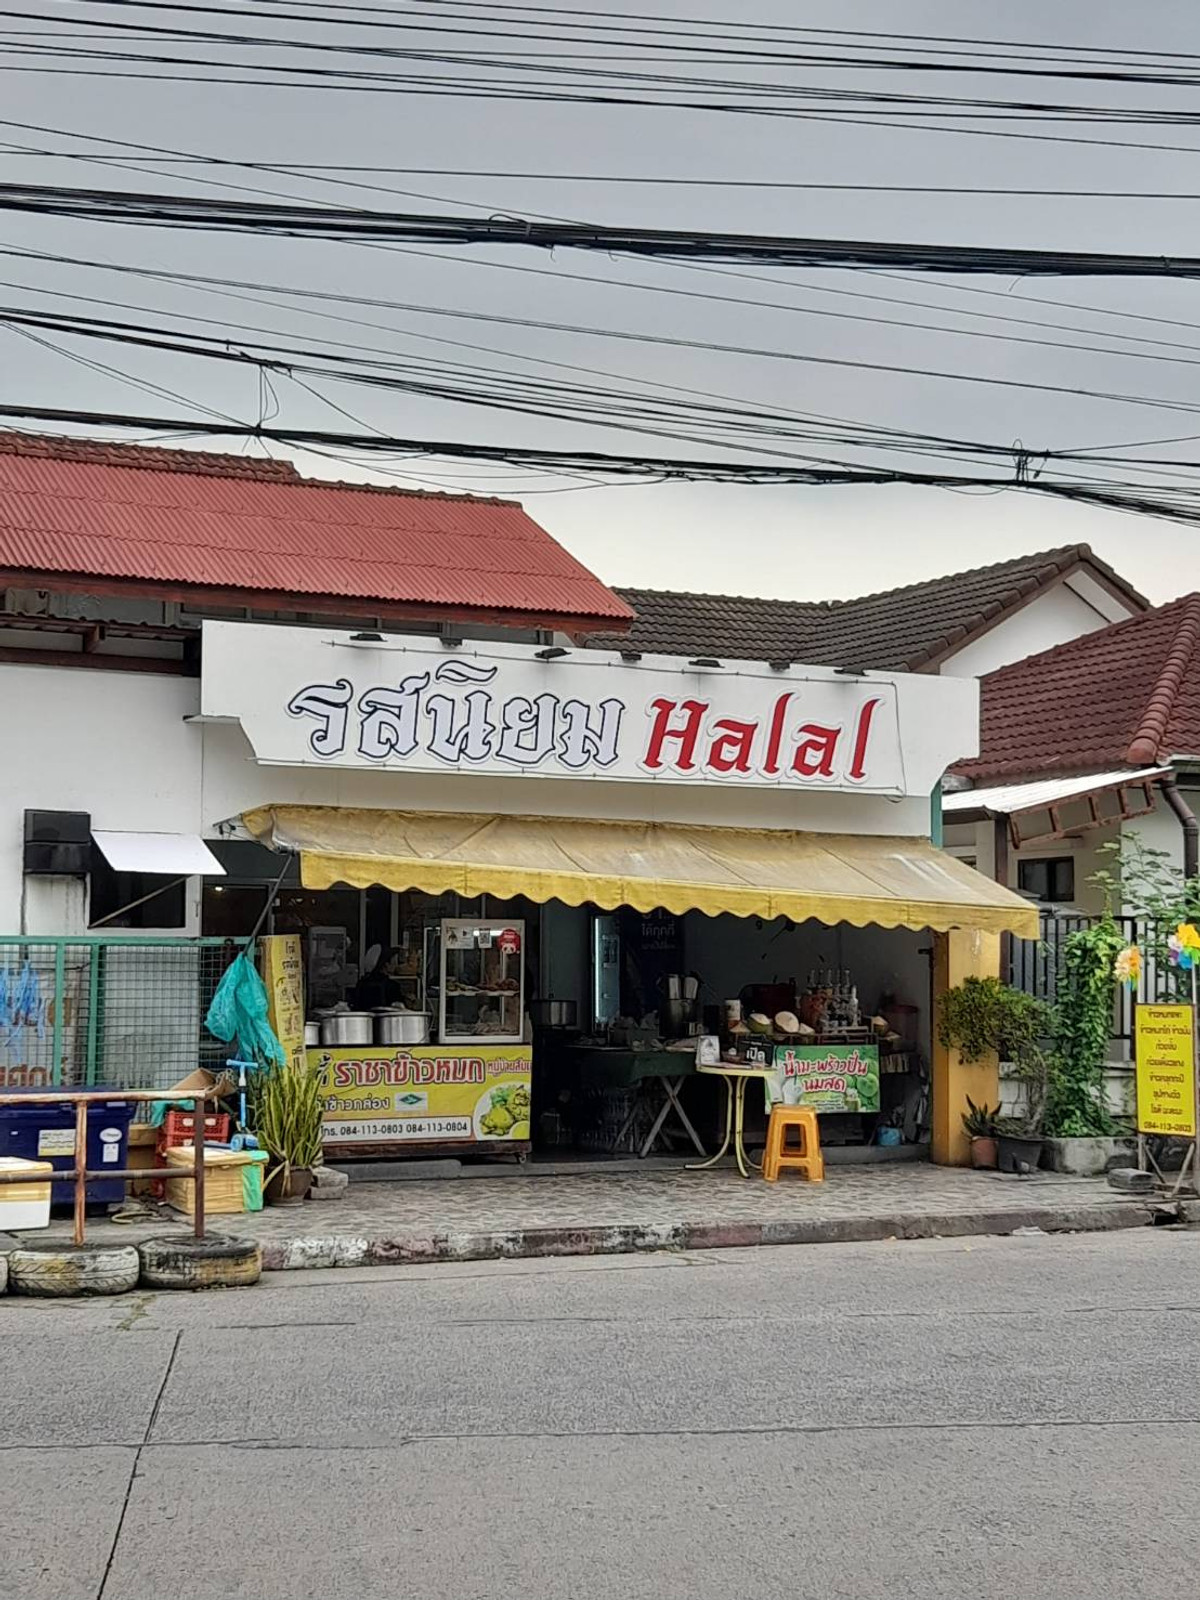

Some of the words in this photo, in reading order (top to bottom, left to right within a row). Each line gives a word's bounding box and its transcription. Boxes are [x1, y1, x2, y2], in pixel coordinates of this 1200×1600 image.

[286, 660, 624, 768] รสนิยม
[643, 691, 881, 779] Halal
[335, 1051, 485, 1087] ราชาข้าวหมก
[783, 1050, 867, 1076] น้ำมะพร้าวปั่น
[803, 1077, 846, 1092] นมสด
[340, 1124, 403, 1136] 084-113-0803
[406, 1122, 467, 1134] 084-113-0804
